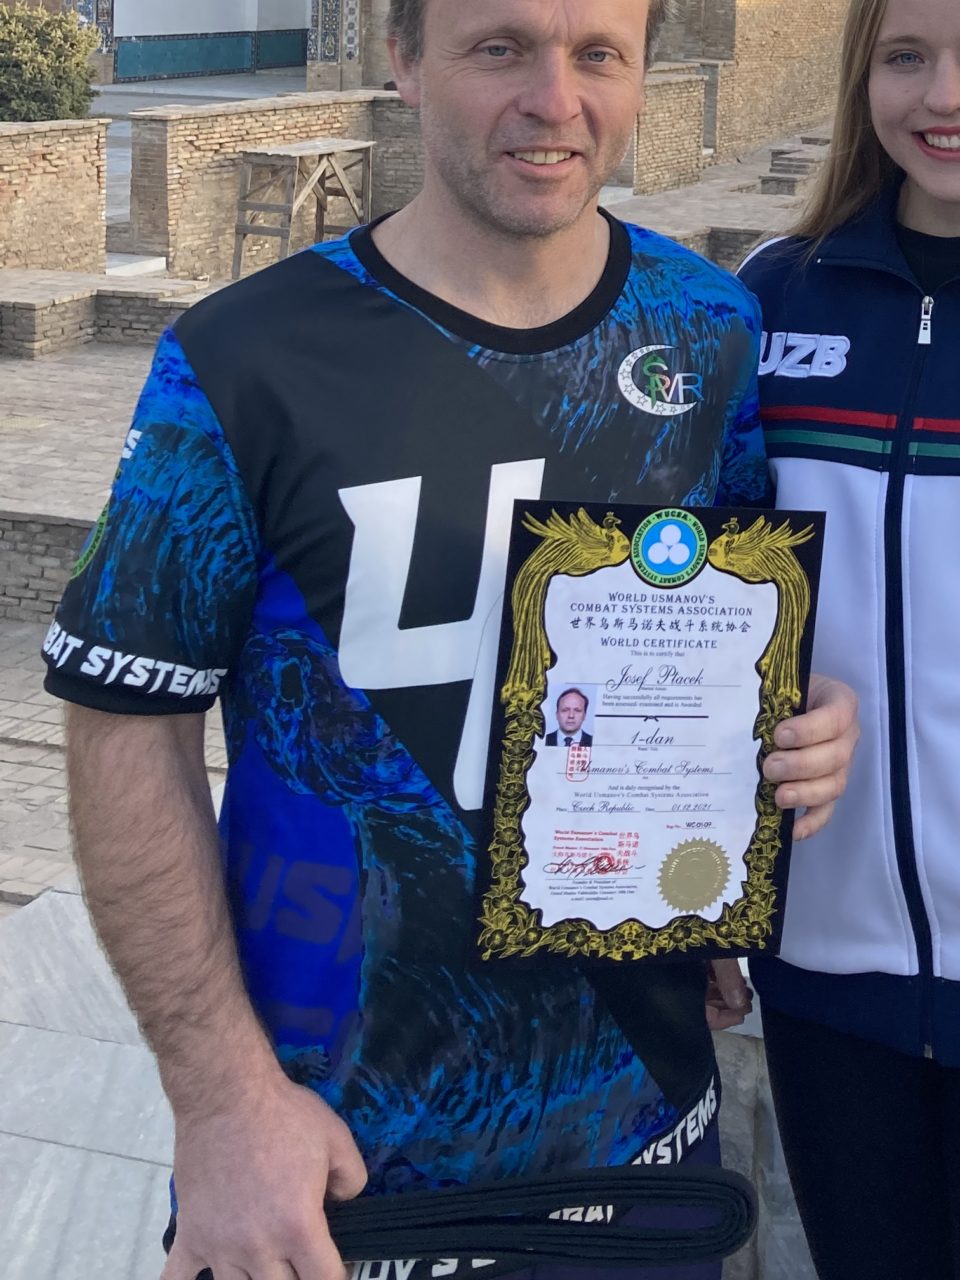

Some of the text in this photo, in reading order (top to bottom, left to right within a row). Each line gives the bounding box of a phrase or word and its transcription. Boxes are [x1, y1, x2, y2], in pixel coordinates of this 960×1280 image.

[758, 331, 850, 378] UZB
[609, 592, 715, 604] WORLD USMANOV'S
[570, 603, 753, 616] COMBAT SYSTEMS ASSOCIATION
[601, 637, 718, 649] WORLD CERTIFICATE
[80, 645, 229, 698] SYSTEMS
[606, 663, 704, 692] Josef Ptacek
[632, 728, 675, 745] 1-dan
[635, 760, 671, 774] Combat
[674, 760, 714, 778] Systems
[571, 801, 594, 812] Czech
[598, 801, 635, 814] Republic
[671, 803, 711, 811] 01.12.2021
